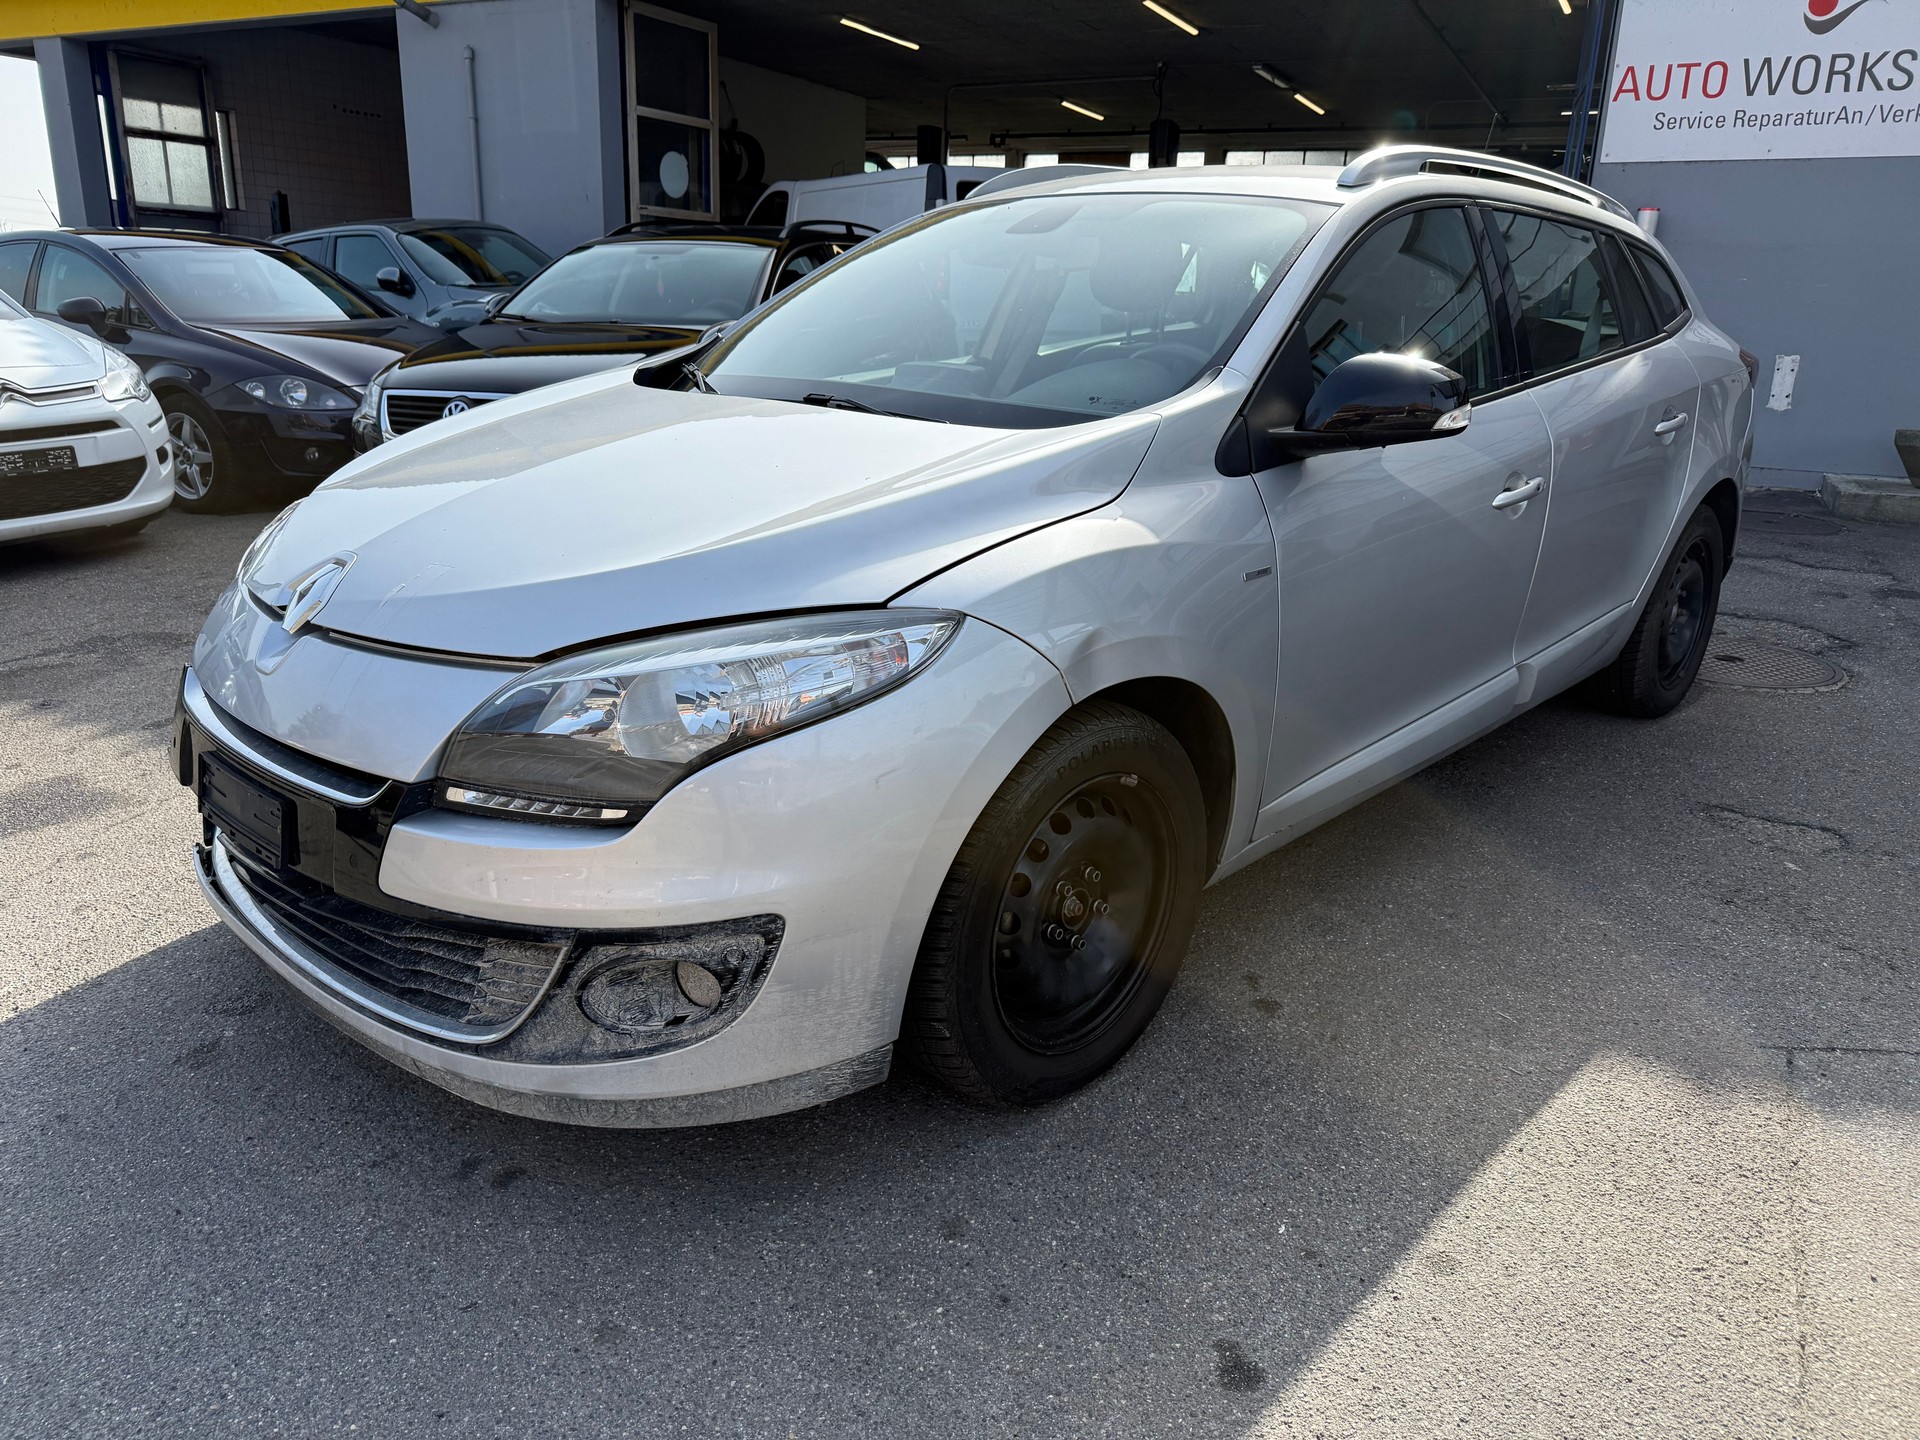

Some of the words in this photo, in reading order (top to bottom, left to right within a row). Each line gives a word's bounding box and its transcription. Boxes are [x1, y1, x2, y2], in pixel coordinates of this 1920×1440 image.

[1612, 60, 1729, 103] AUTO
[1743, 48, 1919, 97] WORKS
[1653, 110, 1726, 131] Service
[1056, 736, 1128, 781] POLARIS
